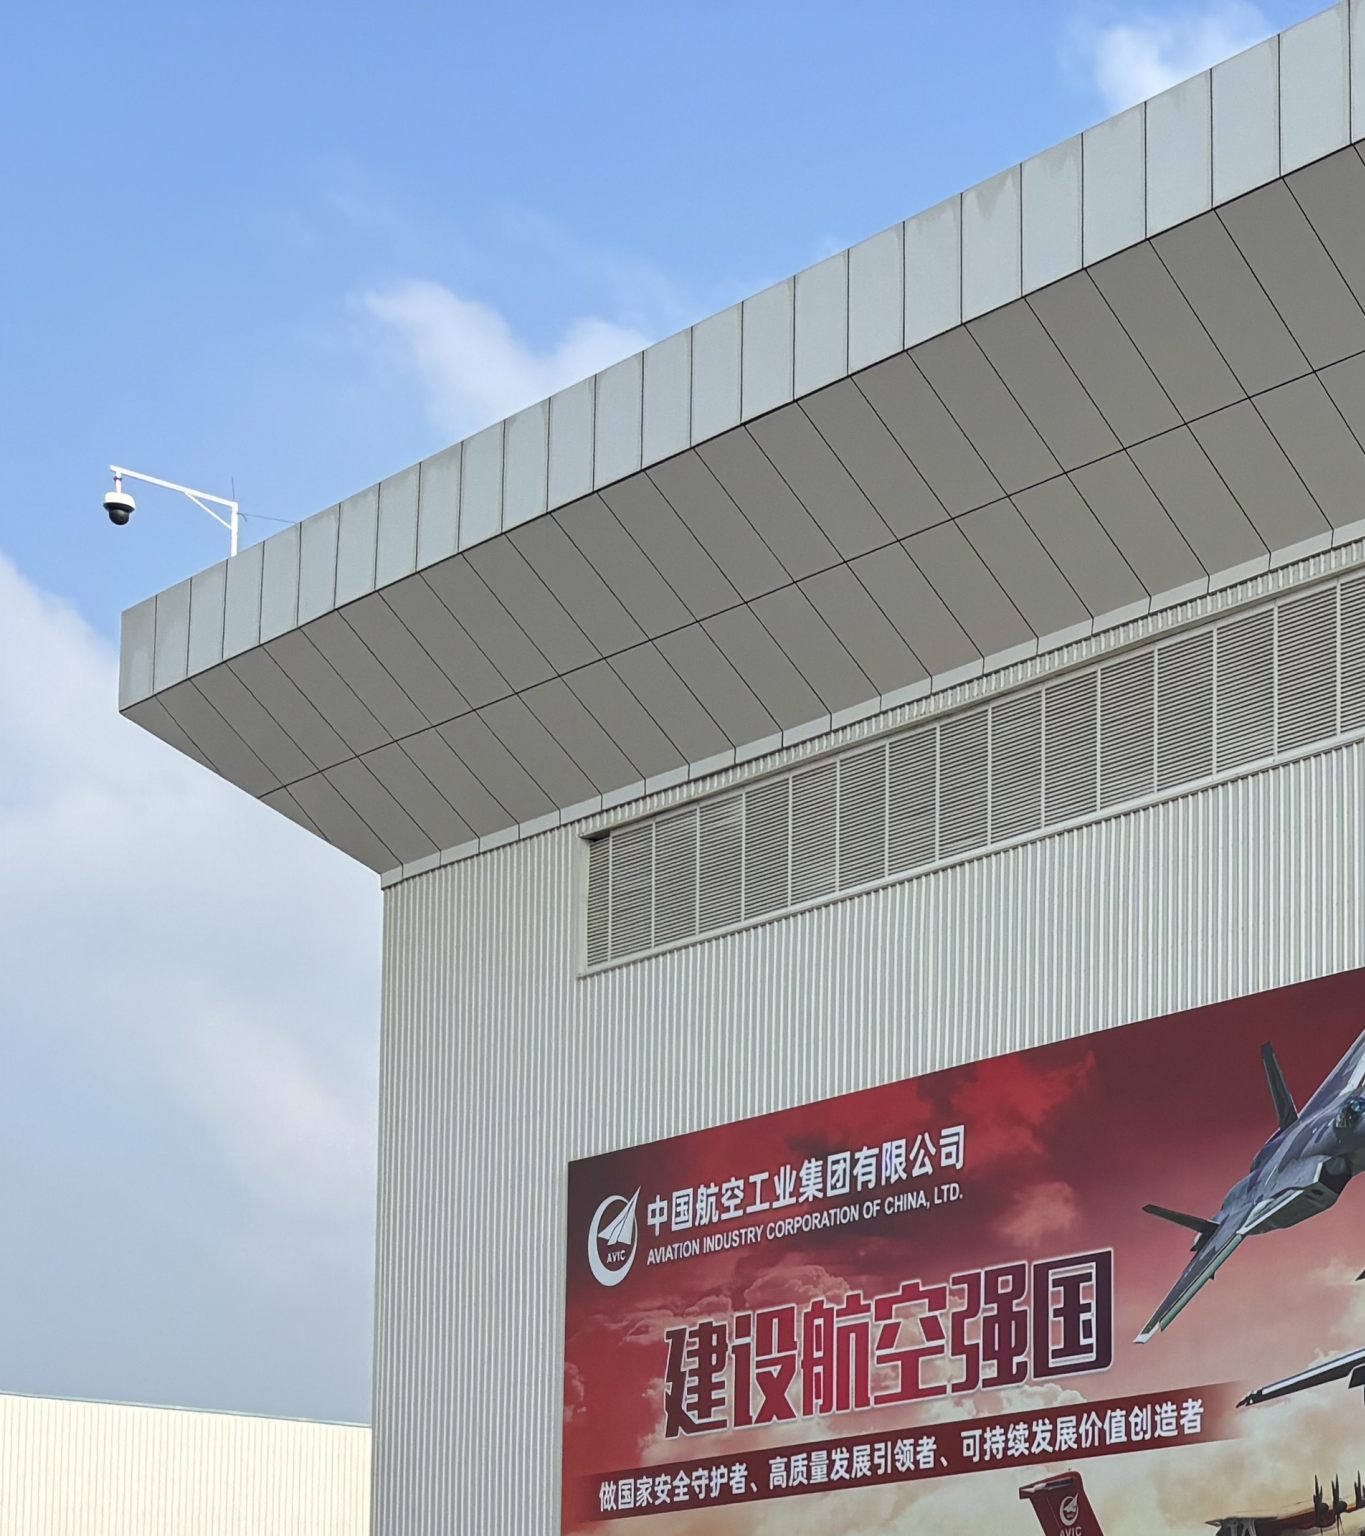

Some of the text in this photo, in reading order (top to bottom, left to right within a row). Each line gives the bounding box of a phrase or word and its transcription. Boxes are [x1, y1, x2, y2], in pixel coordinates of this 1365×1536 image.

[647, 1125, 965, 1237] 中国航空工业集团有限公司
[647, 1183, 963, 1265] AVIATION INDUSTRY CORPORATION OF CHINA, LTD.
[606, 1250, 626, 1264] AVIC
[664, 1248, 1114, 1439] 建设航空强国
